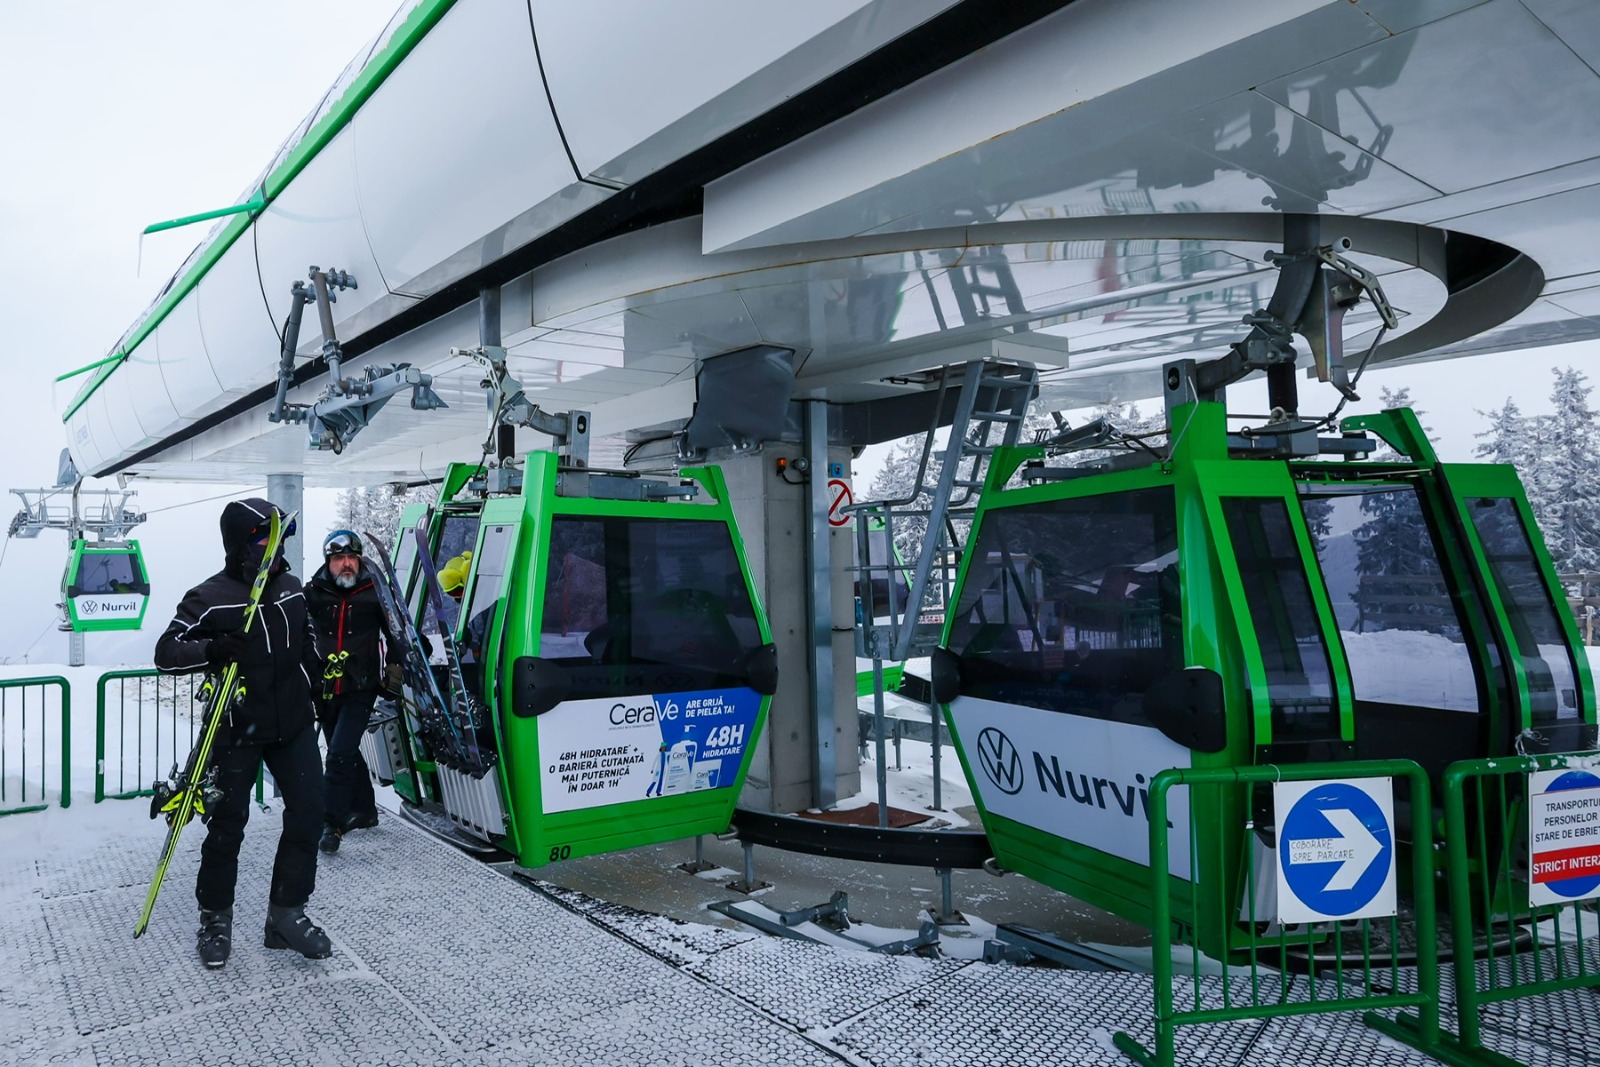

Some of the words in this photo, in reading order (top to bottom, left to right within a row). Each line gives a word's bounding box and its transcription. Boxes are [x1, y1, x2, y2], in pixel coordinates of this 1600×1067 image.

[101, 601, 136, 612] Nurvil
[686, 699, 701, 709] ARE
[609, 699, 679, 726] CeraVe
[685, 709, 696, 718] DE
[697, 706, 722, 717] PIELEA
[724, 705, 735, 714] TA!
[705, 724, 745, 748] 48H
[560, 751, 577, 761] 48H
[549, 765, 556, 774] O
[558, 758, 598, 773] BARIERĂ
[601, 753, 645, 768] CUTANATĂ
[561, 774, 579, 784] MAI
[581, 765, 630, 781] PUTERNICĂ
[567, 782, 577, 793] ÎN
[580, 781, 604, 792] DOAR
[1032, 751, 1174, 829] Nurvi
[1545, 798, 1600, 812] TRANSPORTU
[1544, 812, 1598, 827] PERSONELOR
[1535, 831, 1560, 842] STARE
[1562, 829, 1573, 839] DE
[549, 845, 571, 861] 80
[1292, 851, 1312, 862] SPRE
[1317, 849, 1355, 860] PARCARE
[1533, 859, 1567, 875] STRICT
